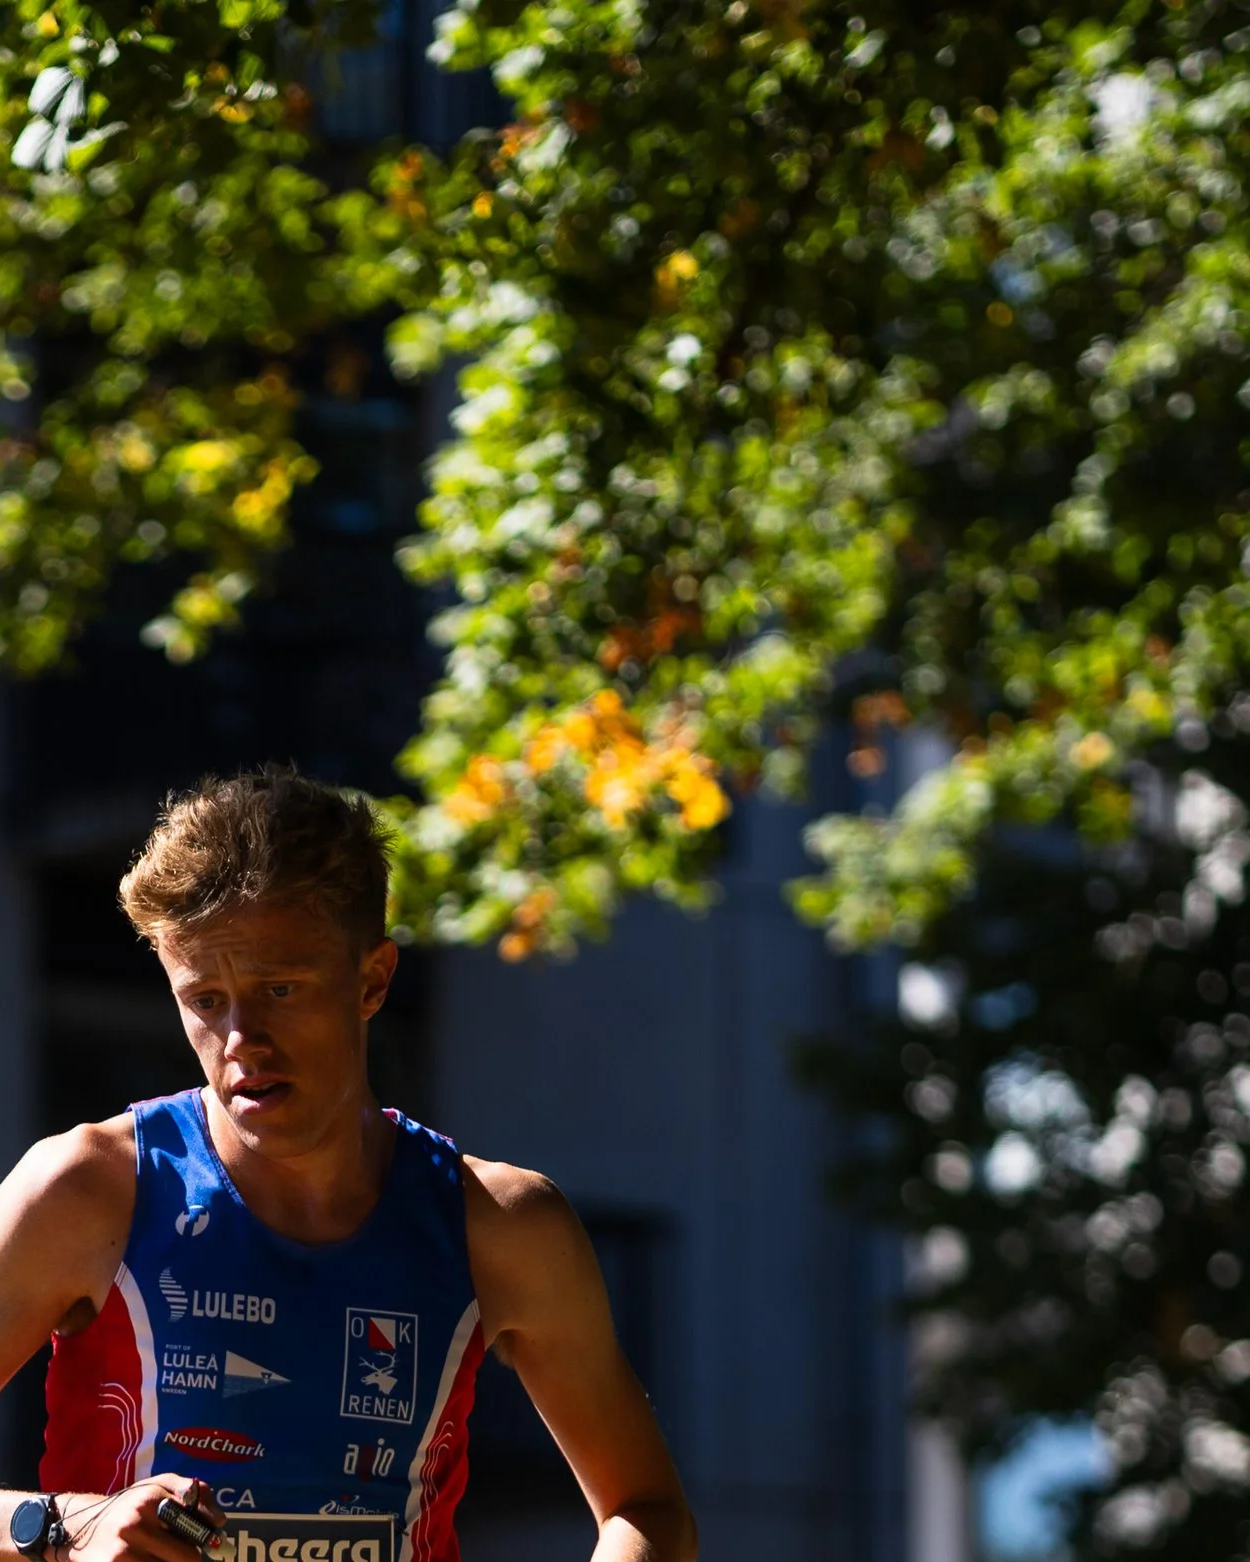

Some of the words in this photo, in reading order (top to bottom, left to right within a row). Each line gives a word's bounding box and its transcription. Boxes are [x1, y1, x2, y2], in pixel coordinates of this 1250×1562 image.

[192, 1290, 276, 1325] LULEBO
[351, 1316, 365, 1338] O
[399, 1322, 411, 1344] K
[163, 1352, 218, 1371] LULEÅ
[161, 1370, 218, 1391] HAMN
[348, 1395, 410, 1420] RENEN
[163, 1431, 266, 1458] NordChark
